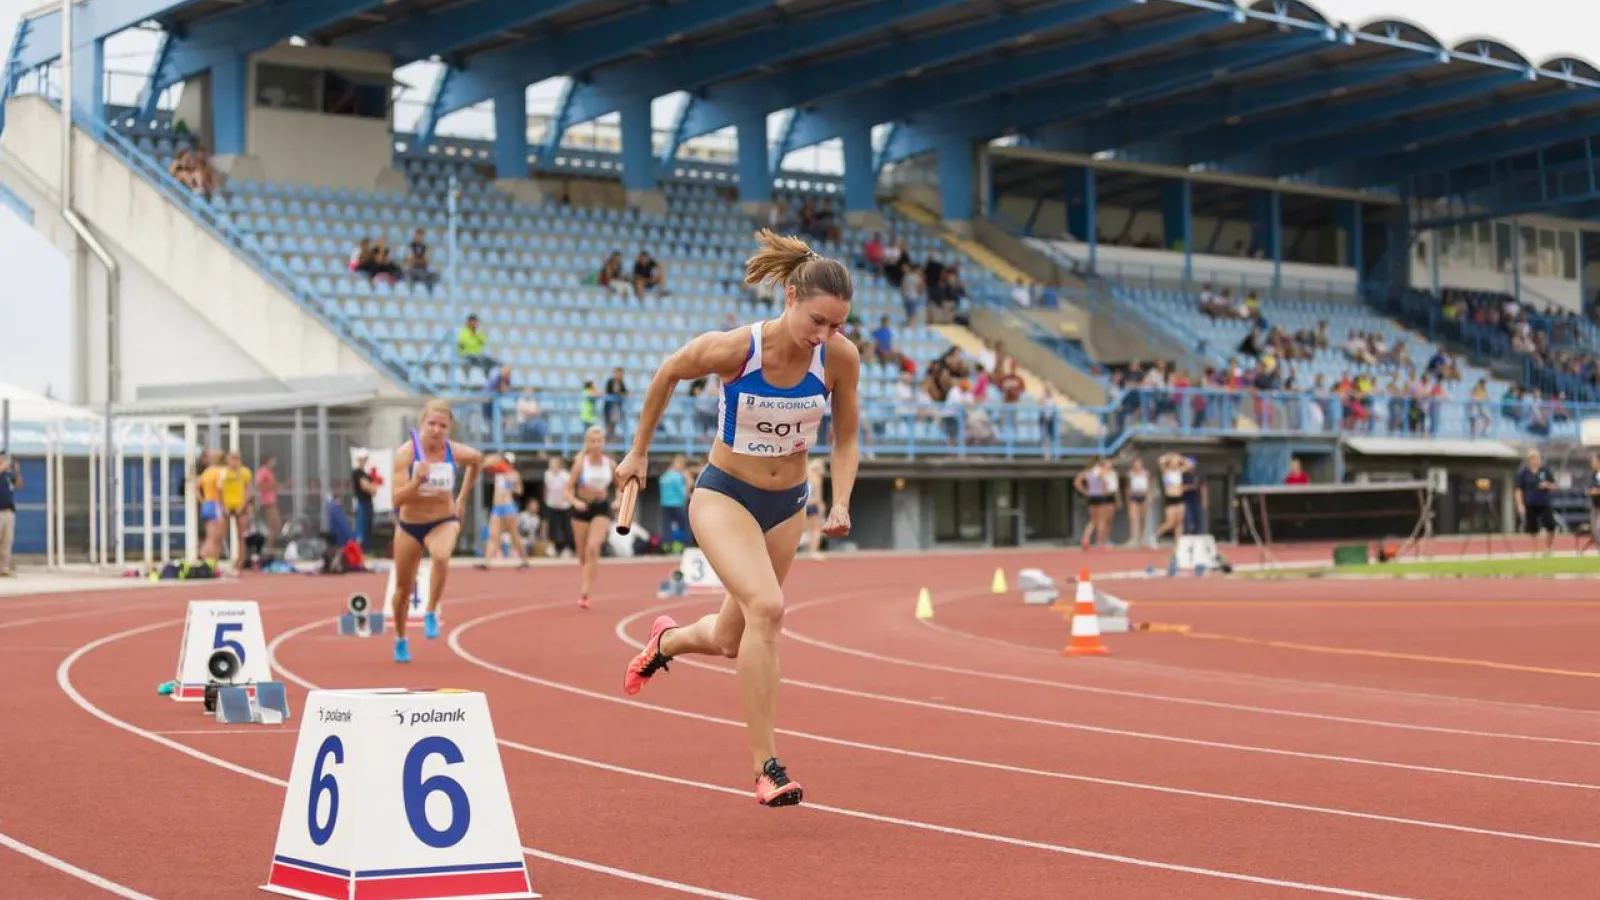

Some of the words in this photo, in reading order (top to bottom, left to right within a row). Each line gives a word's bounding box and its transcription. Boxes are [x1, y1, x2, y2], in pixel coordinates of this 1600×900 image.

[759, 401, 775, 409] AK
[778, 400, 818, 409] GORICA
[691, 557, 705, 581] 3
[213, 623, 246, 667] 5
[308, 734, 344, 845] 6
[403, 736, 471, 848] 6
